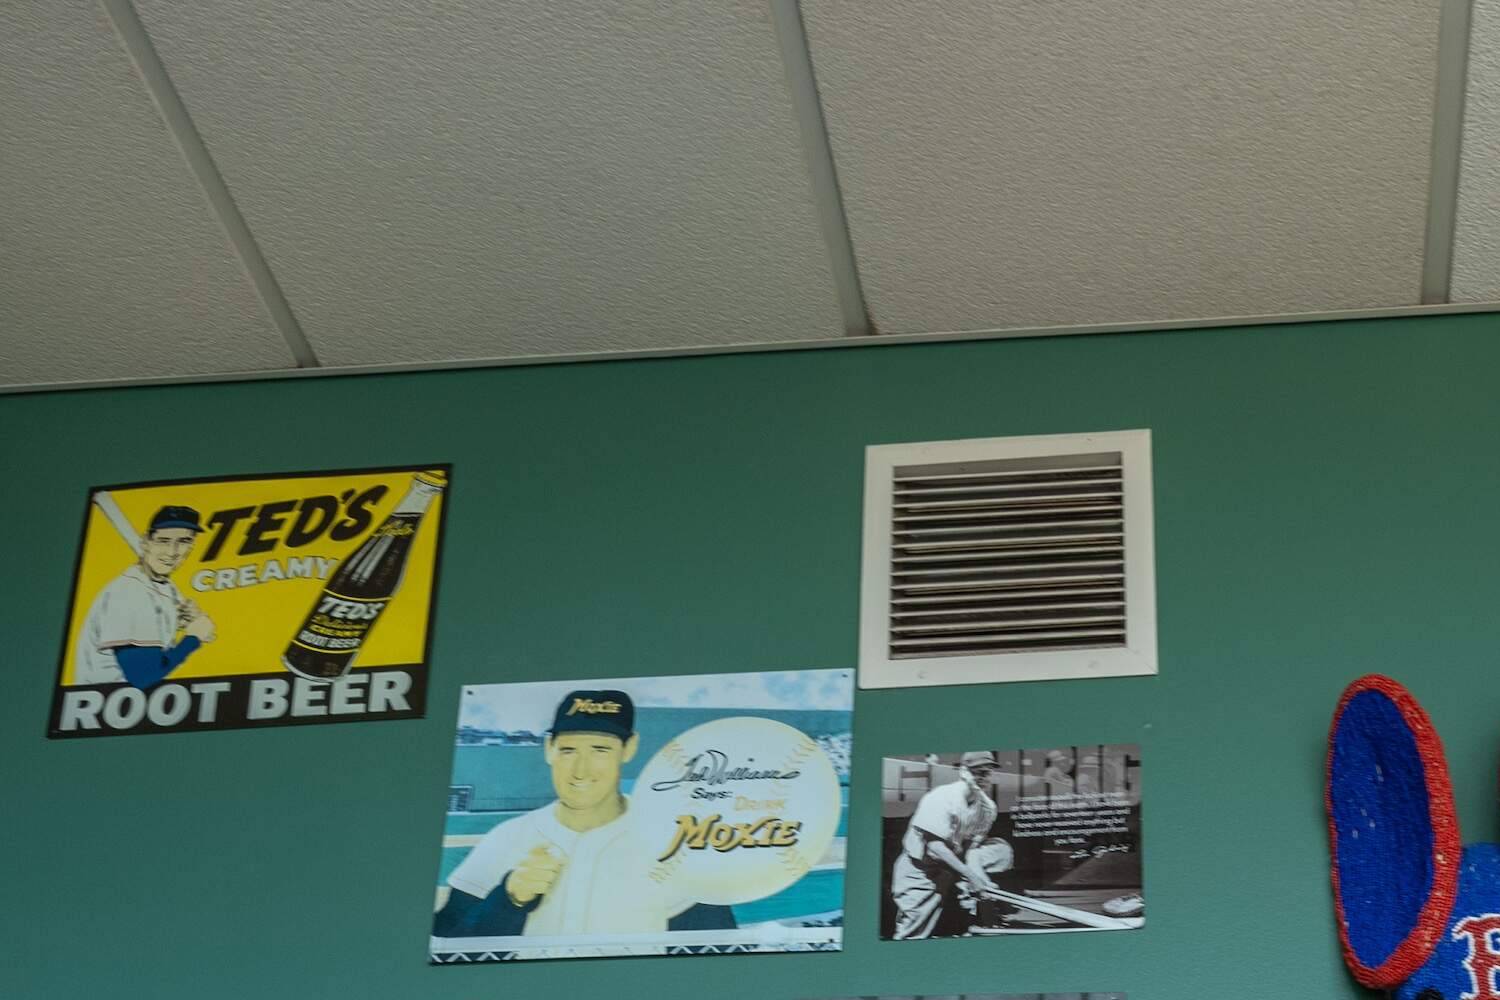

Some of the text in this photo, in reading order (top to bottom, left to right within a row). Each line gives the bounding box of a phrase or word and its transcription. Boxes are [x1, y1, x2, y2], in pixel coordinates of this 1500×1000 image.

[199, 485, 389, 562] TED'S
[191, 555, 340, 593] CREAMY
[318, 596, 385, 620] TED'S
[58, 671, 413, 732] ROOT BEER
[691, 787, 733, 801] Says:
